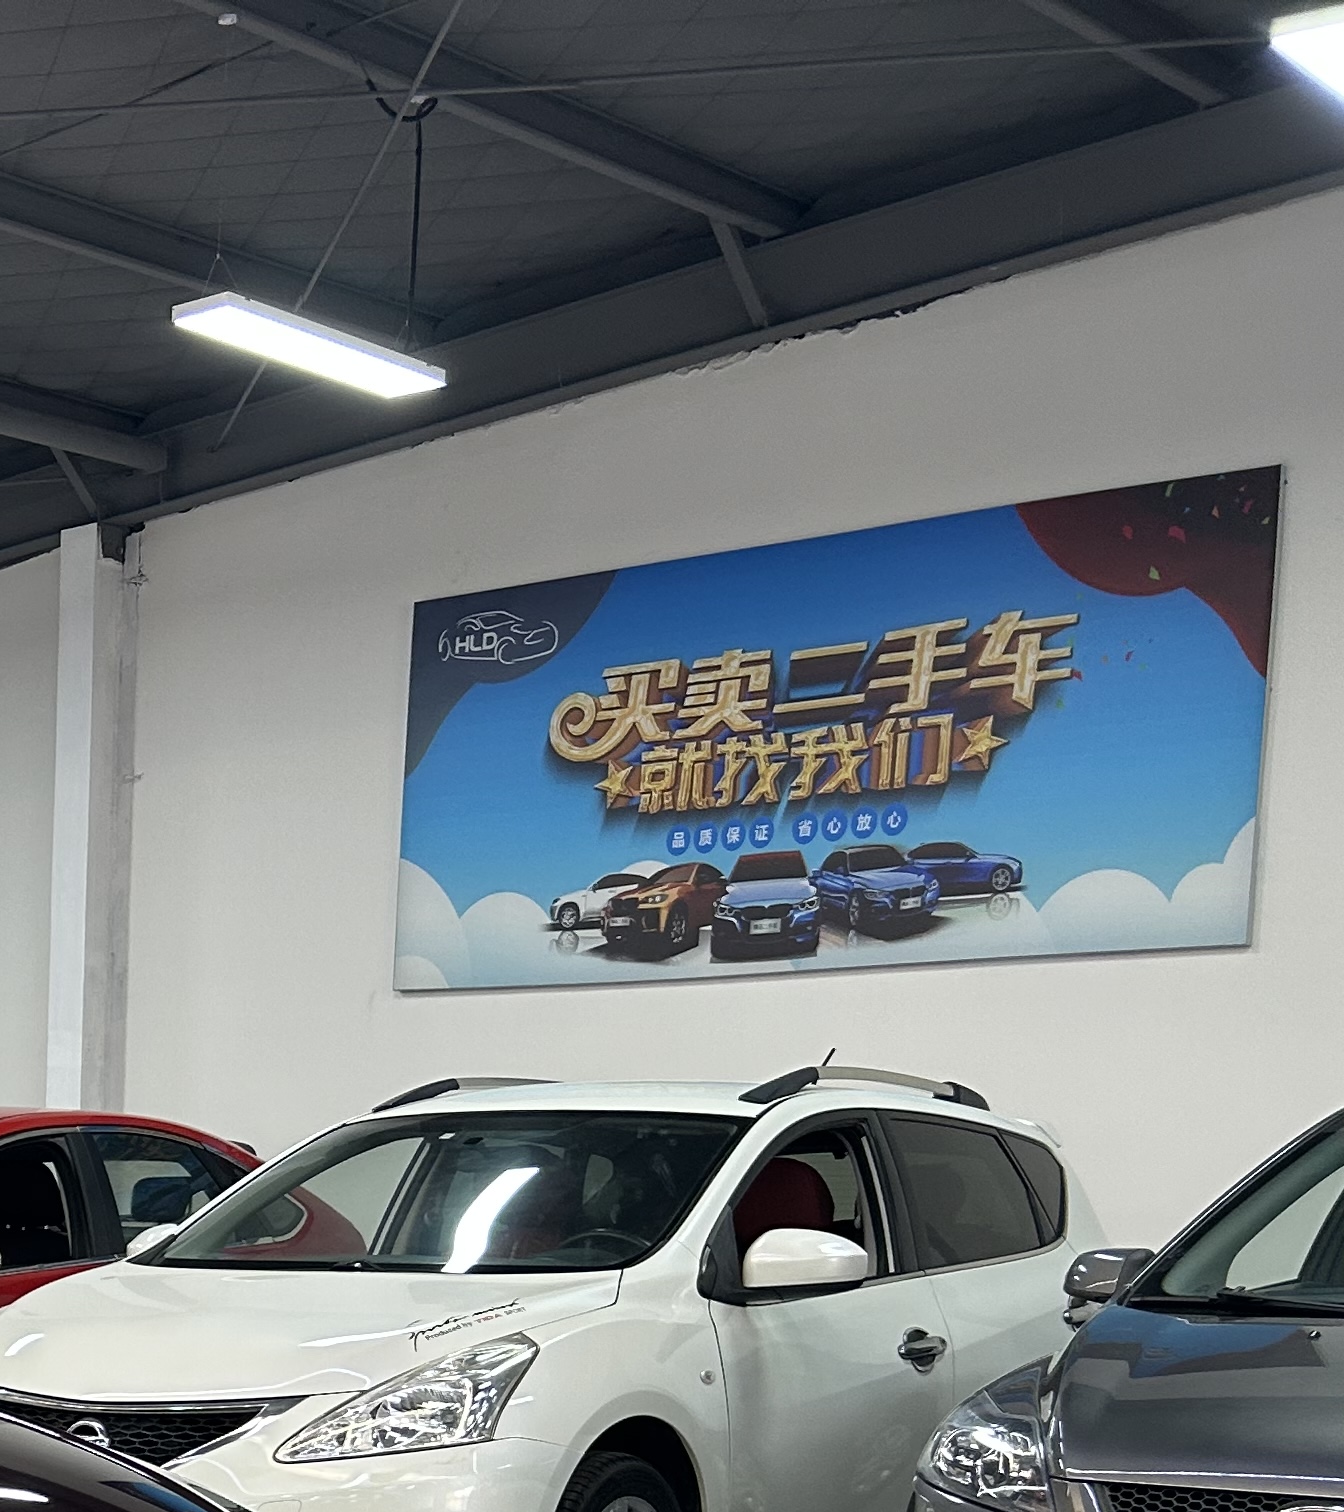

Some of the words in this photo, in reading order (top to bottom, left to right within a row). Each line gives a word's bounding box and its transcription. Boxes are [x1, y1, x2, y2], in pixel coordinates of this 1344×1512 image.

[454, 631, 498, 655] HLD
[548, 610, 1080, 764] 买卖二手车
[638, 709, 955, 814] 就找我们
[671, 825, 770, 849] 品质保证
[797, 810, 903, 838] 省心放心
